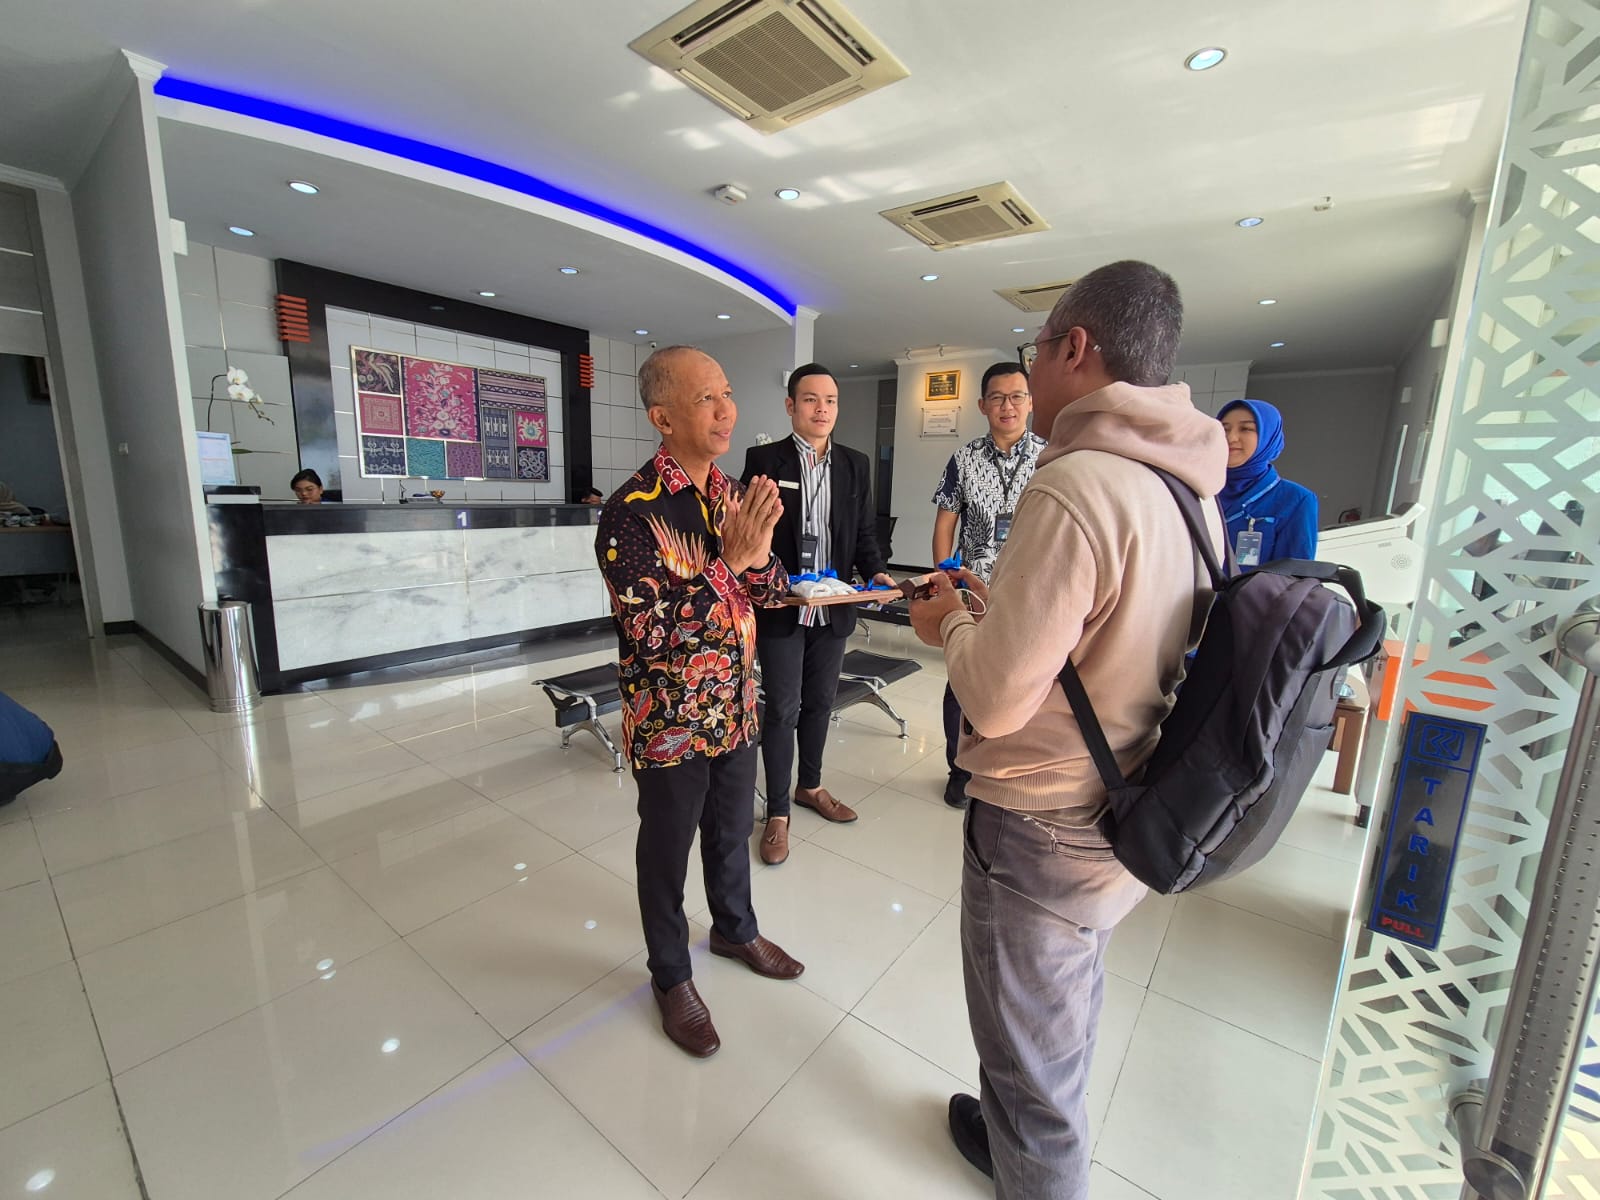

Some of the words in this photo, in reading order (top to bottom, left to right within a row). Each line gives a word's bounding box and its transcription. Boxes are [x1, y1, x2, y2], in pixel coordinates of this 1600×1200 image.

[457, 510, 468, 527] 1
[1396, 776, 1443, 911] TARIK
[1380, 915, 1425, 939] PULL
